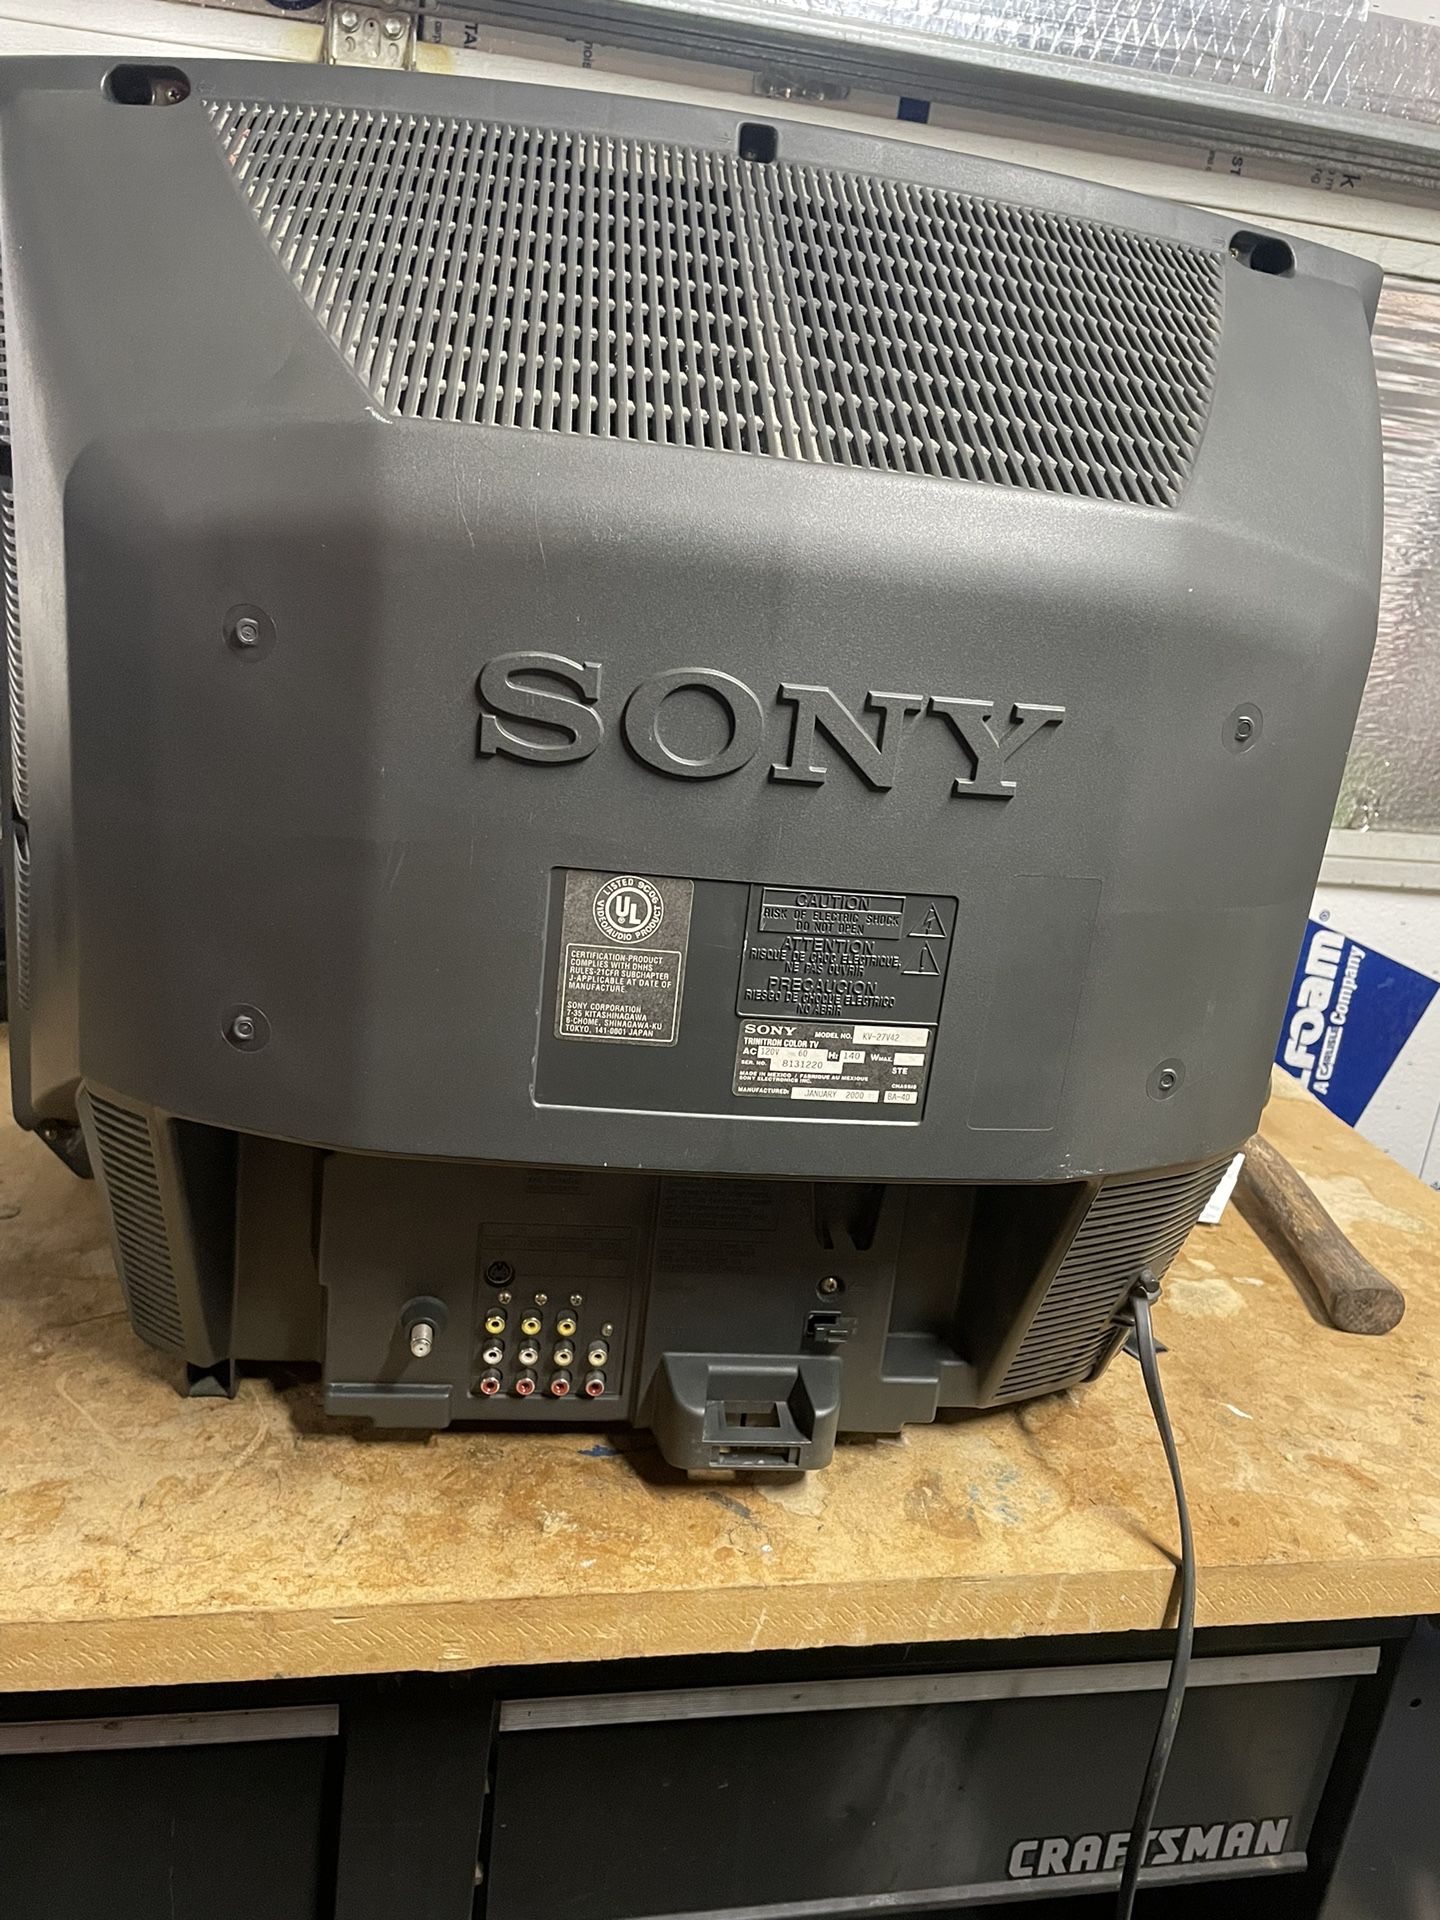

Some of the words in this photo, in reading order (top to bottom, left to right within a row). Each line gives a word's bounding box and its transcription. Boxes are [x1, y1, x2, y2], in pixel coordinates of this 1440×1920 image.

[473, 649, 1066, 800] SONY
[603, 878, 634, 896] LISTED
[637, 881, 659, 904] 9C06
[795, 893, 871, 911] CAUTION
[615, 895, 641, 925] UL
[596, 899, 632, 941] VIDEO/AUDIO
[634, 905, 661, 939] PRODUCT
[763, 908, 788, 920] RISK
[793, 910, 806, 921] OF
[812, 912, 859, 924] ELECTRIC
[866, 914, 899, 927] SHOCK
[795, 921, 810, 932] DO
[813, 922, 834, 934] NOT
[838, 923, 865, 936] OPEN
[781, 936, 876, 955] ATTENTION
[571, 950, 663, 965] CERTIFICATION-PRODUCT
[751, 947, 787, 961] RISQUE
[791, 950, 806, 962] DE
[809, 951, 837, 964] CHOC
[570, 958, 609, 968] COMPLIES
[610, 961, 631, 970] WITH
[632, 963, 653, 972] DHHS
[785, 961, 800, 973] NE
[804, 962, 824, 975] PAS
[828, 963, 865, 977] OUVRIR
[570, 966, 620, 977] RULES-21CFR
[621, 970, 669, 980] SUBCHAPTER
[569, 974, 624, 985] J-APPLICABLE
[626, 978, 637, 986] AT
[639, 979, 659, 988] DATE
[661, 980, 672, 988] OF
[768, 975, 878, 996] PRECAUCION
[745, 988, 781, 1001] RIESGO
[784, 991, 799, 1003] DE
[802, 992, 842, 1005] CHOQUE
[844, 994, 896, 1008] ELECTRICO
[567, 1000, 588, 1010] SONY
[590, 1003, 642, 1014] CORPORATION
[796, 1003, 812, 1015] NO
[813, 1004, 842, 1017] ABRIR
[566, 1009, 582, 1017] 7-35
[584, 1010, 647, 1022] KITASHINAGAWA
[1313, 1081, 1329, 1095] A
[1330, 945, 1366, 1026] Company
[604, 1019, 662, 1030] SHINAGAWA-KU
[744, 1023, 797, 1036] SONY
[628, 1028, 654, 1037] JAPAN
[814, 1031, 839, 1039] MODEL
[840, 1032, 853, 1040] NO.
[862, 1033, 900, 1041] KV-27V42
[744, 1037, 783, 1047] TRINITRON
[784, 1039, 808, 1048] COLOR
[809, 1041, 820, 1049] TV
[742, 1047, 757, 1055] AC
[761, 1047, 780, 1056] 120V
[828, 1051, 839, 1060] Hz
[843, 1052, 861, 1060] 140
[782, 1060, 824, 1070] 8131220
[891, 1067, 909, 1075] STE
[737, 1086, 790, 1095] MANUFACTURED:
[804, 1089, 837, 1099] JANUARY
[845, 1091, 864, 1100] 2000
